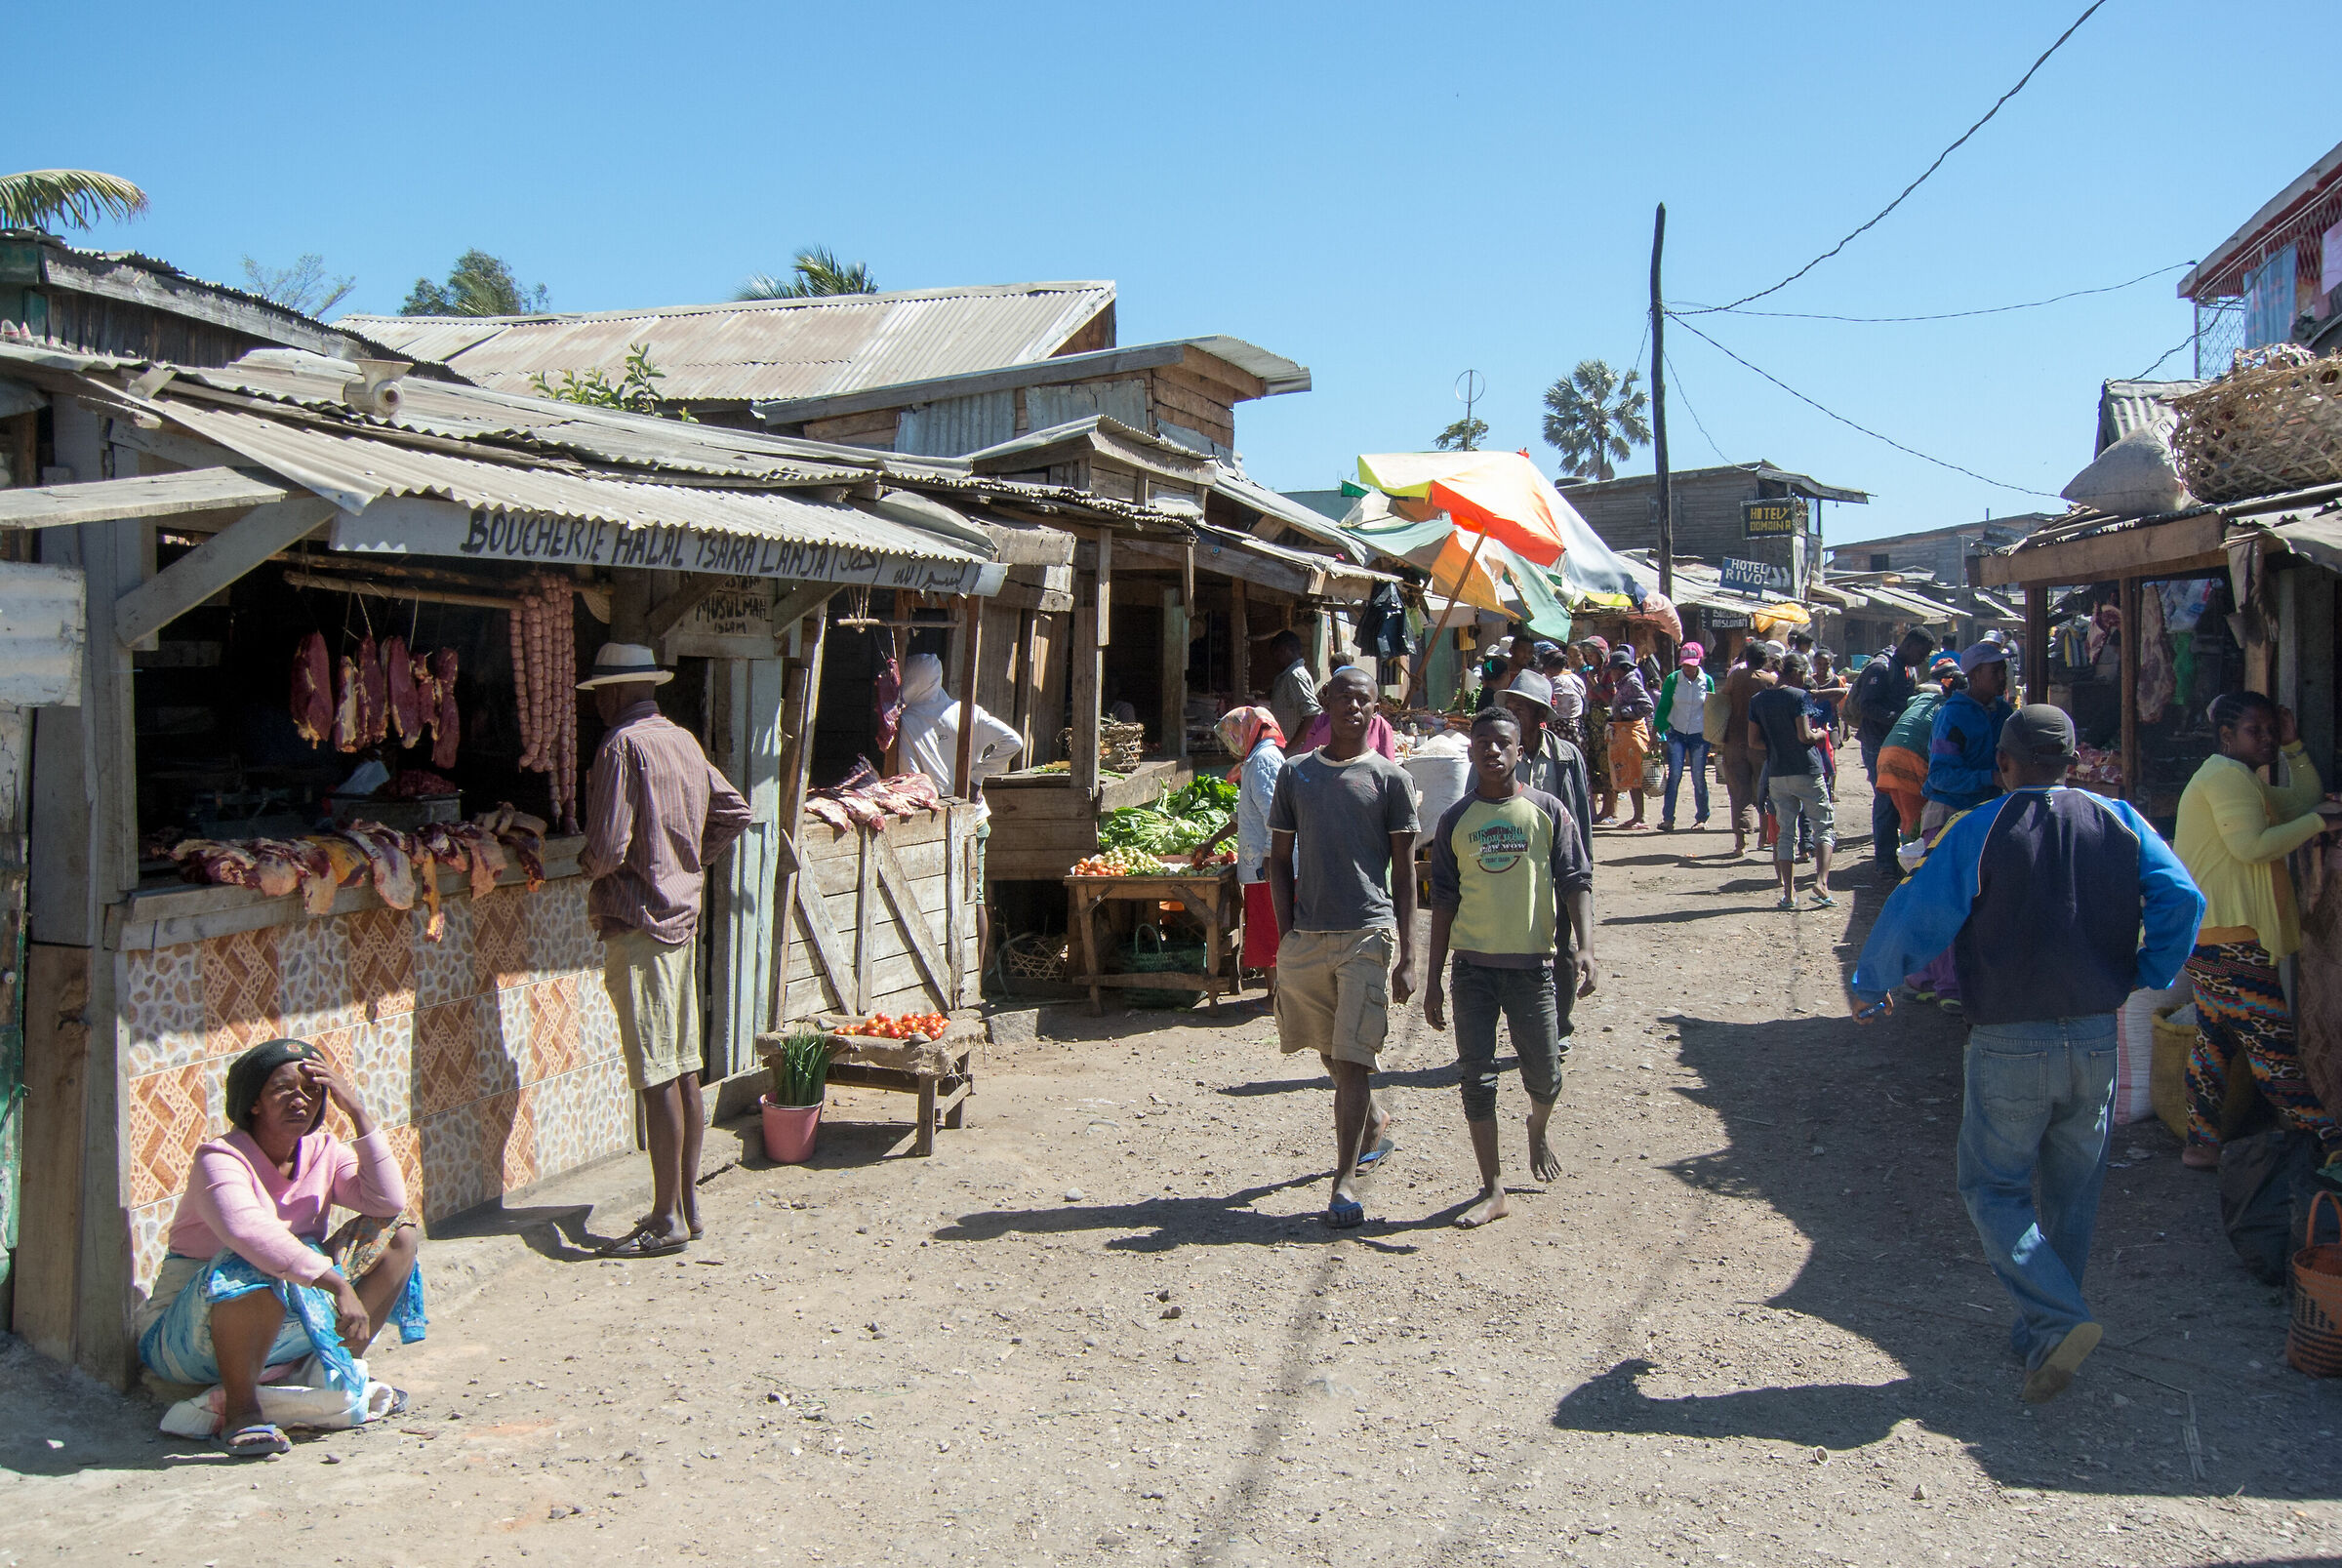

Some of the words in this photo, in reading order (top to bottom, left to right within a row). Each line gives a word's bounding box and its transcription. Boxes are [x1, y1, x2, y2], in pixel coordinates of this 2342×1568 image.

[460, 509, 608, 562] BOUCHERIE
[610, 522, 683, 568] HALAL
[695, 532, 757, 574] TSARA
[1731, 559, 1767, 575] HOTEL
[1725, 568, 1762, 585] RIVO
